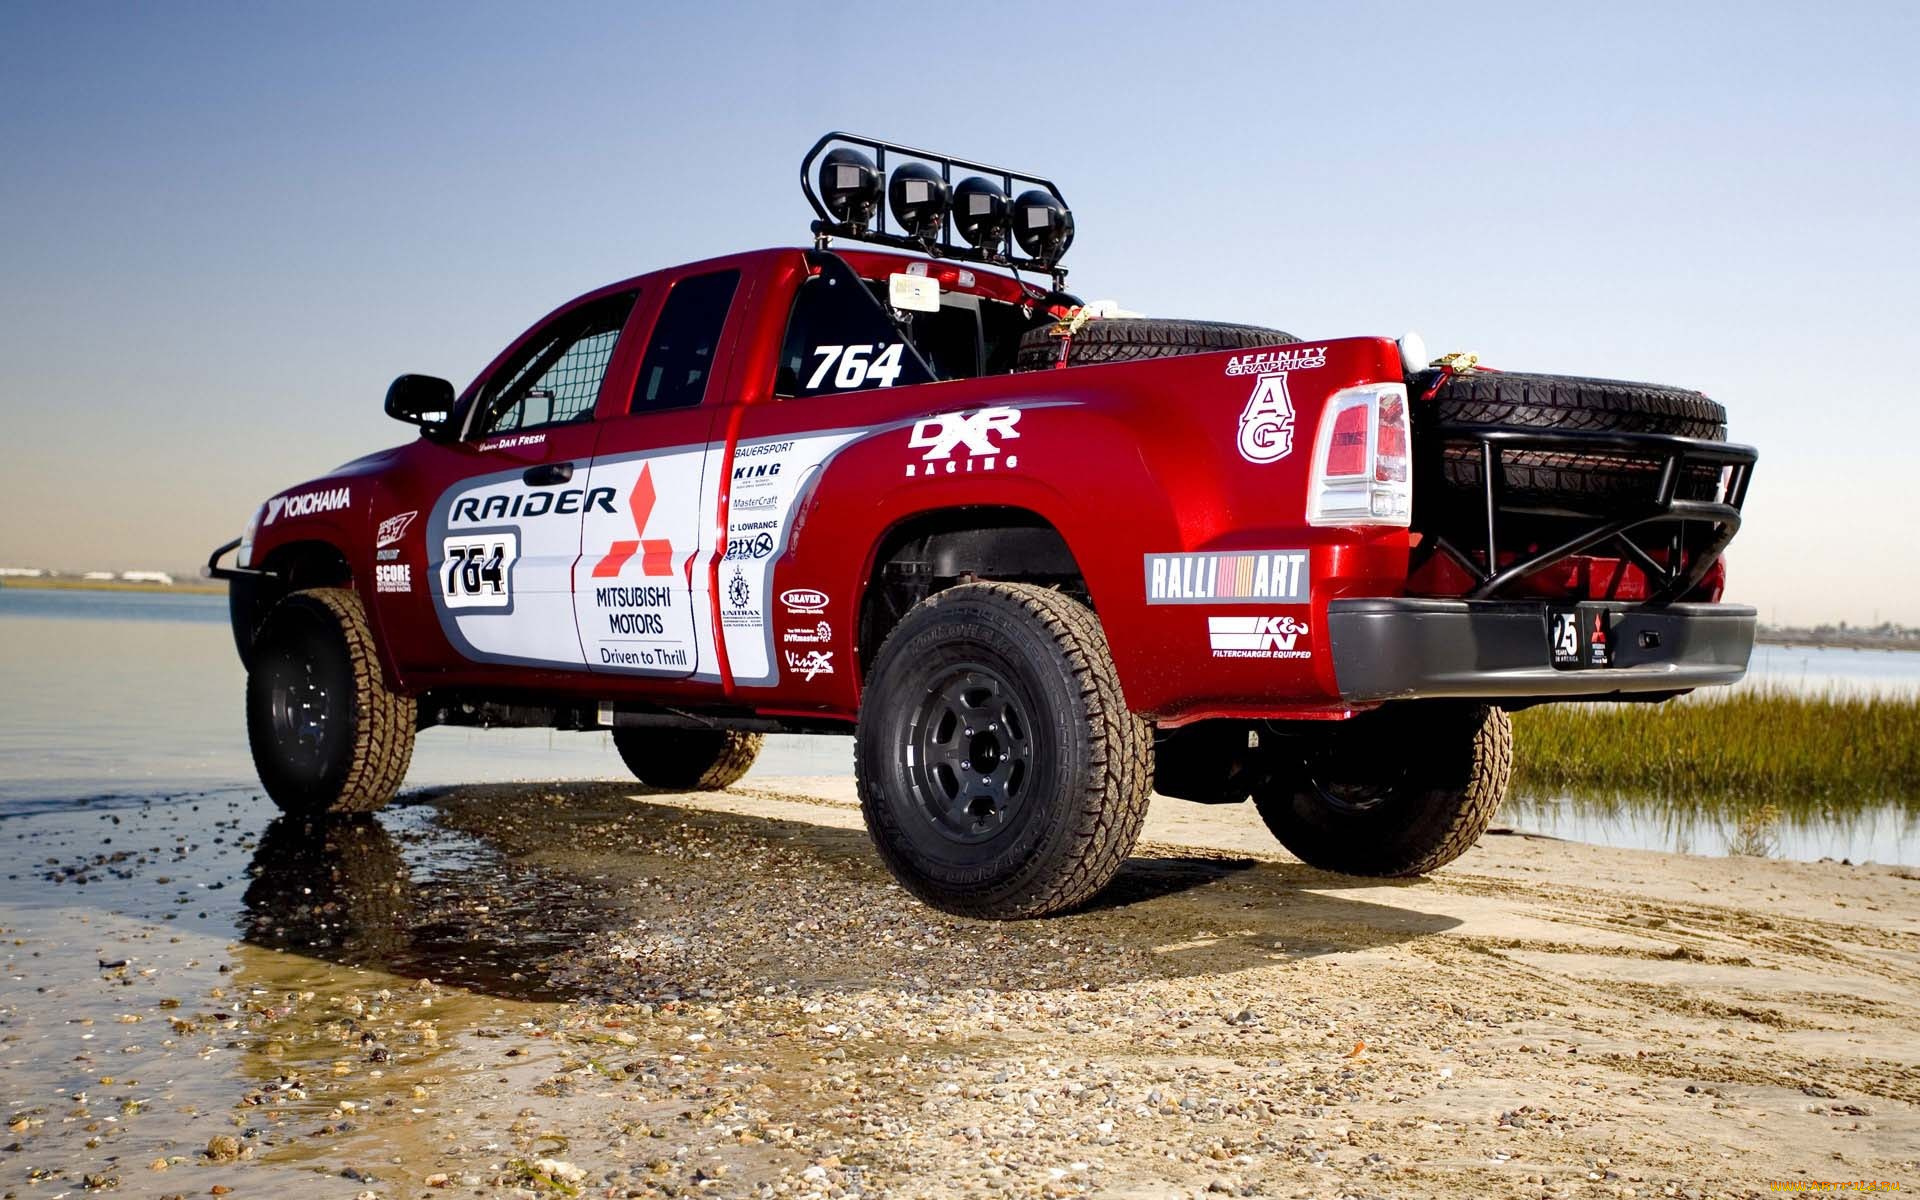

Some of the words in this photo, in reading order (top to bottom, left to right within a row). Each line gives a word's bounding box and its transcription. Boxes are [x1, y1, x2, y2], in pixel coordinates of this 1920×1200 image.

[1227, 347, 1328, 366] AFFINITY
[806, 344, 904, 389] 764
[1225, 357, 1326, 376] GRAPHICS
[499, 439, 517, 449] DAN
[518, 434, 546, 446] FRESH
[907, 406, 1022, 460] DXR
[734, 442, 795, 458] BAUERSPORT
[733, 463, 782, 480] KING
[905, 456, 1018, 476] RACING
[282, 487, 350, 519] YOKOHAMA
[452, 487, 618, 522] RAIDER
[733, 496, 778, 508] MasterCraft
[738, 521, 778, 531] LOWRANCE
[376, 564, 411, 581] SCORE
[446, 543, 506, 596] 764
[597, 587, 671, 608] MITSUBISHI
[788, 594, 821, 603] DEAVER
[609, 614, 665, 634] MOTORS
[1553, 613, 1577, 656] 25
[601, 648, 638, 665] Driven
[641, 651, 654, 665] to
[654, 649, 687, 666] Thrill
[1212, 650, 1272, 658] FILTERCHARGER
[1273, 651, 1312, 659] EQUIPPED
